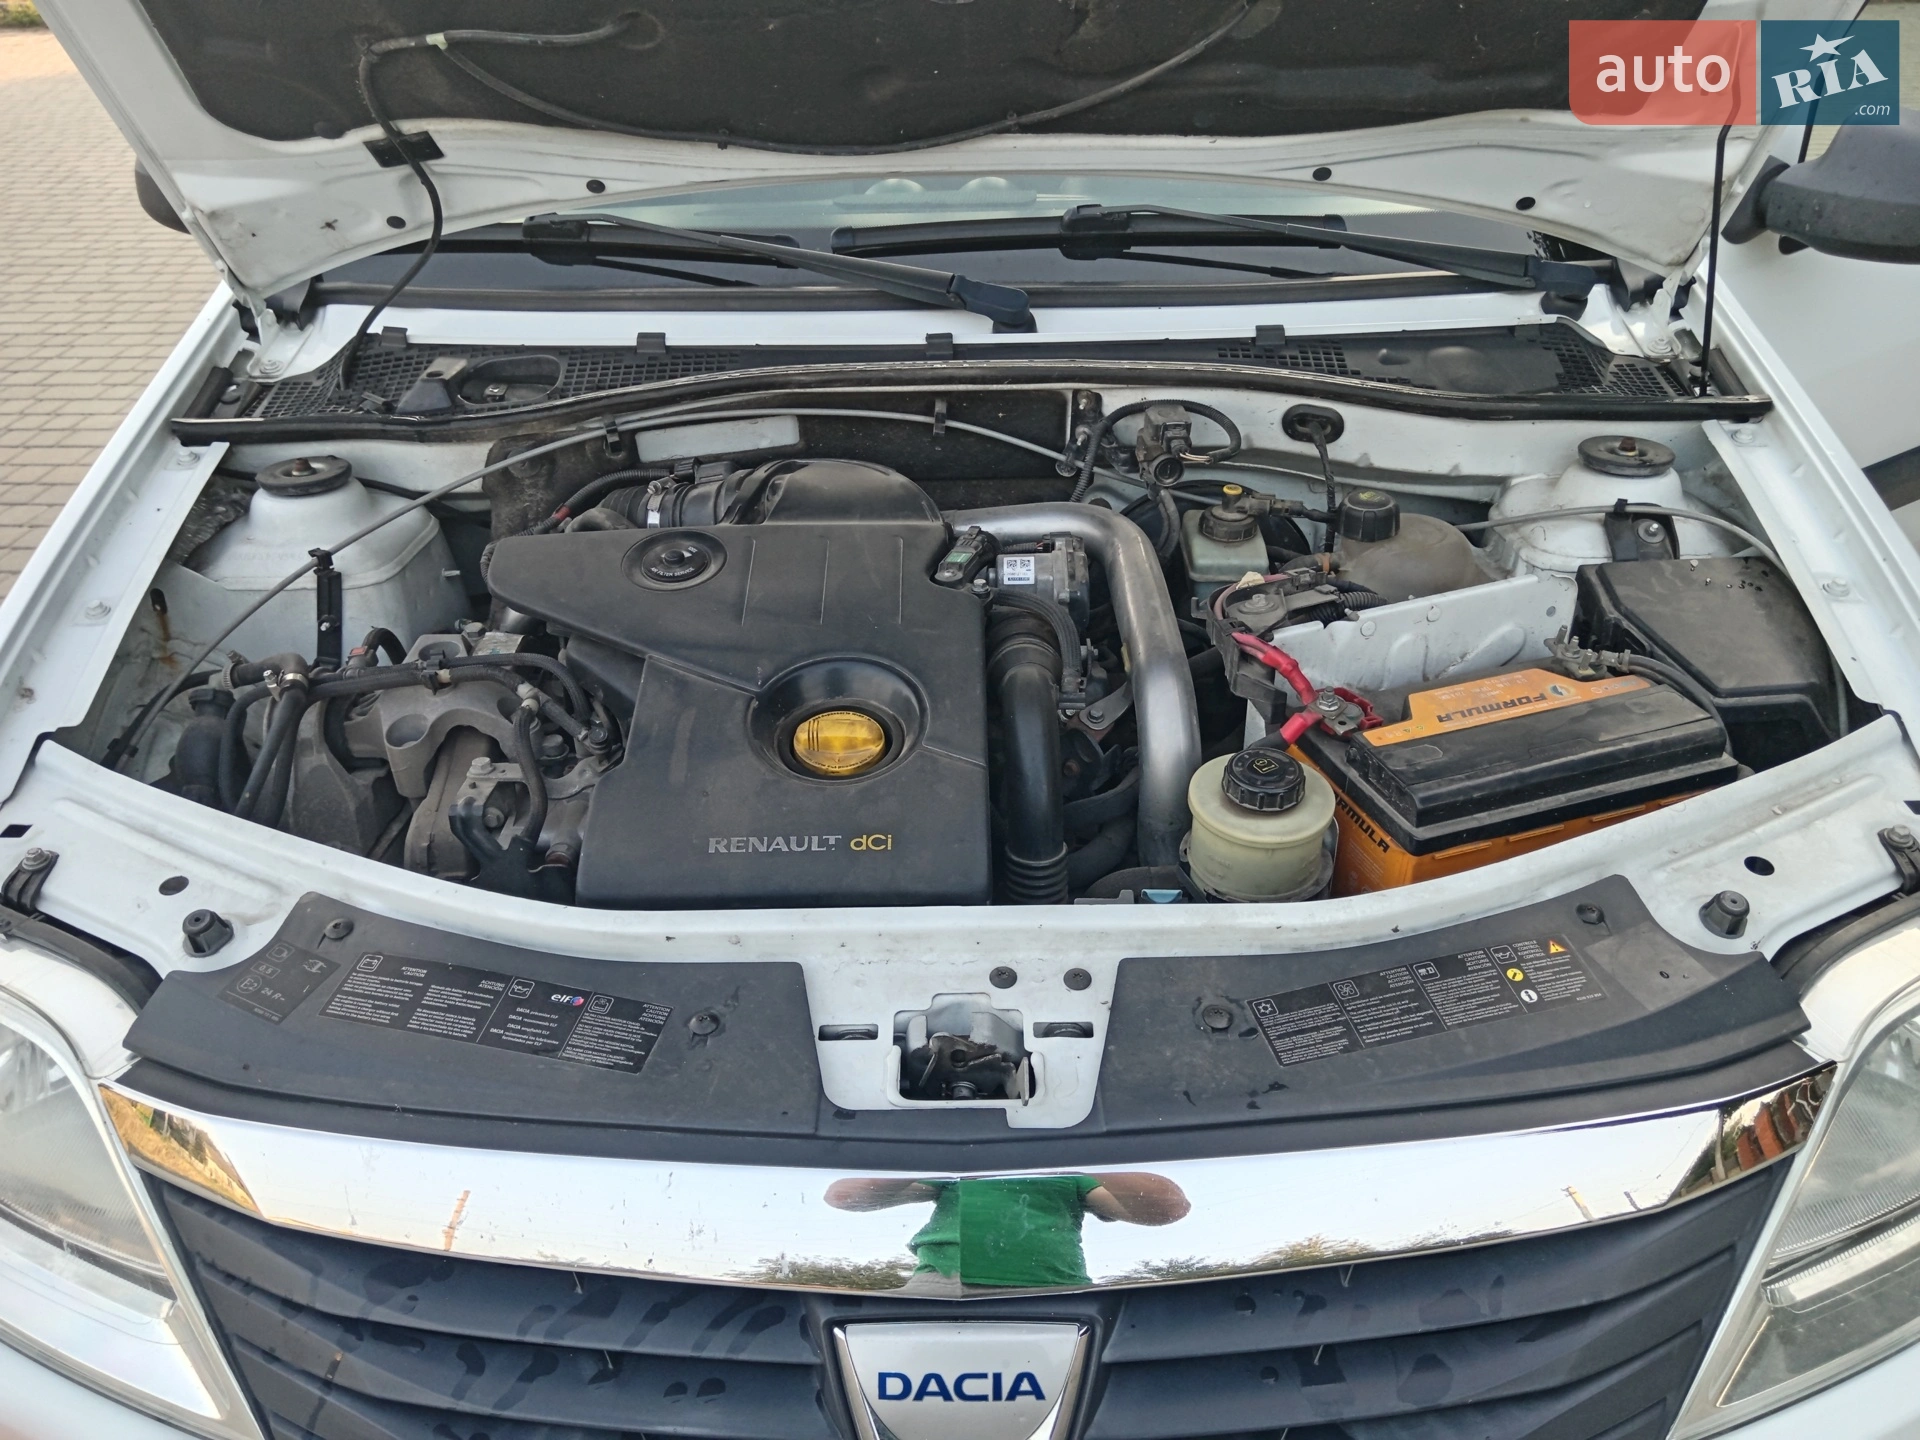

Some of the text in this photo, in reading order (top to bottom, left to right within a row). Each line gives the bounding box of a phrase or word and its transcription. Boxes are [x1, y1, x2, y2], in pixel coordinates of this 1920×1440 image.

[1437, 692, 1549, 723] FORMULA
[1335, 795, 1390, 853] RMULA
[709, 834, 892, 853] RENAULT dCi
[1458, 950, 1484, 959] ATTENTION
[1466, 959, 1489, 967] ACHTUNG
[1379, 967, 1407, 977] ATTENTION
[1386, 971, 1409, 979] CAUTION
[481, 979, 505, 988] ACHTUNG
[551, 994, 572, 1003] elf
[642, 1003, 670, 1012] ATTENTION
[646, 1008, 668, 1016] CAUTION
[642, 1012, 666, 1021] ACHTUNG
[878, 1372, 1046, 1402] DACIA
